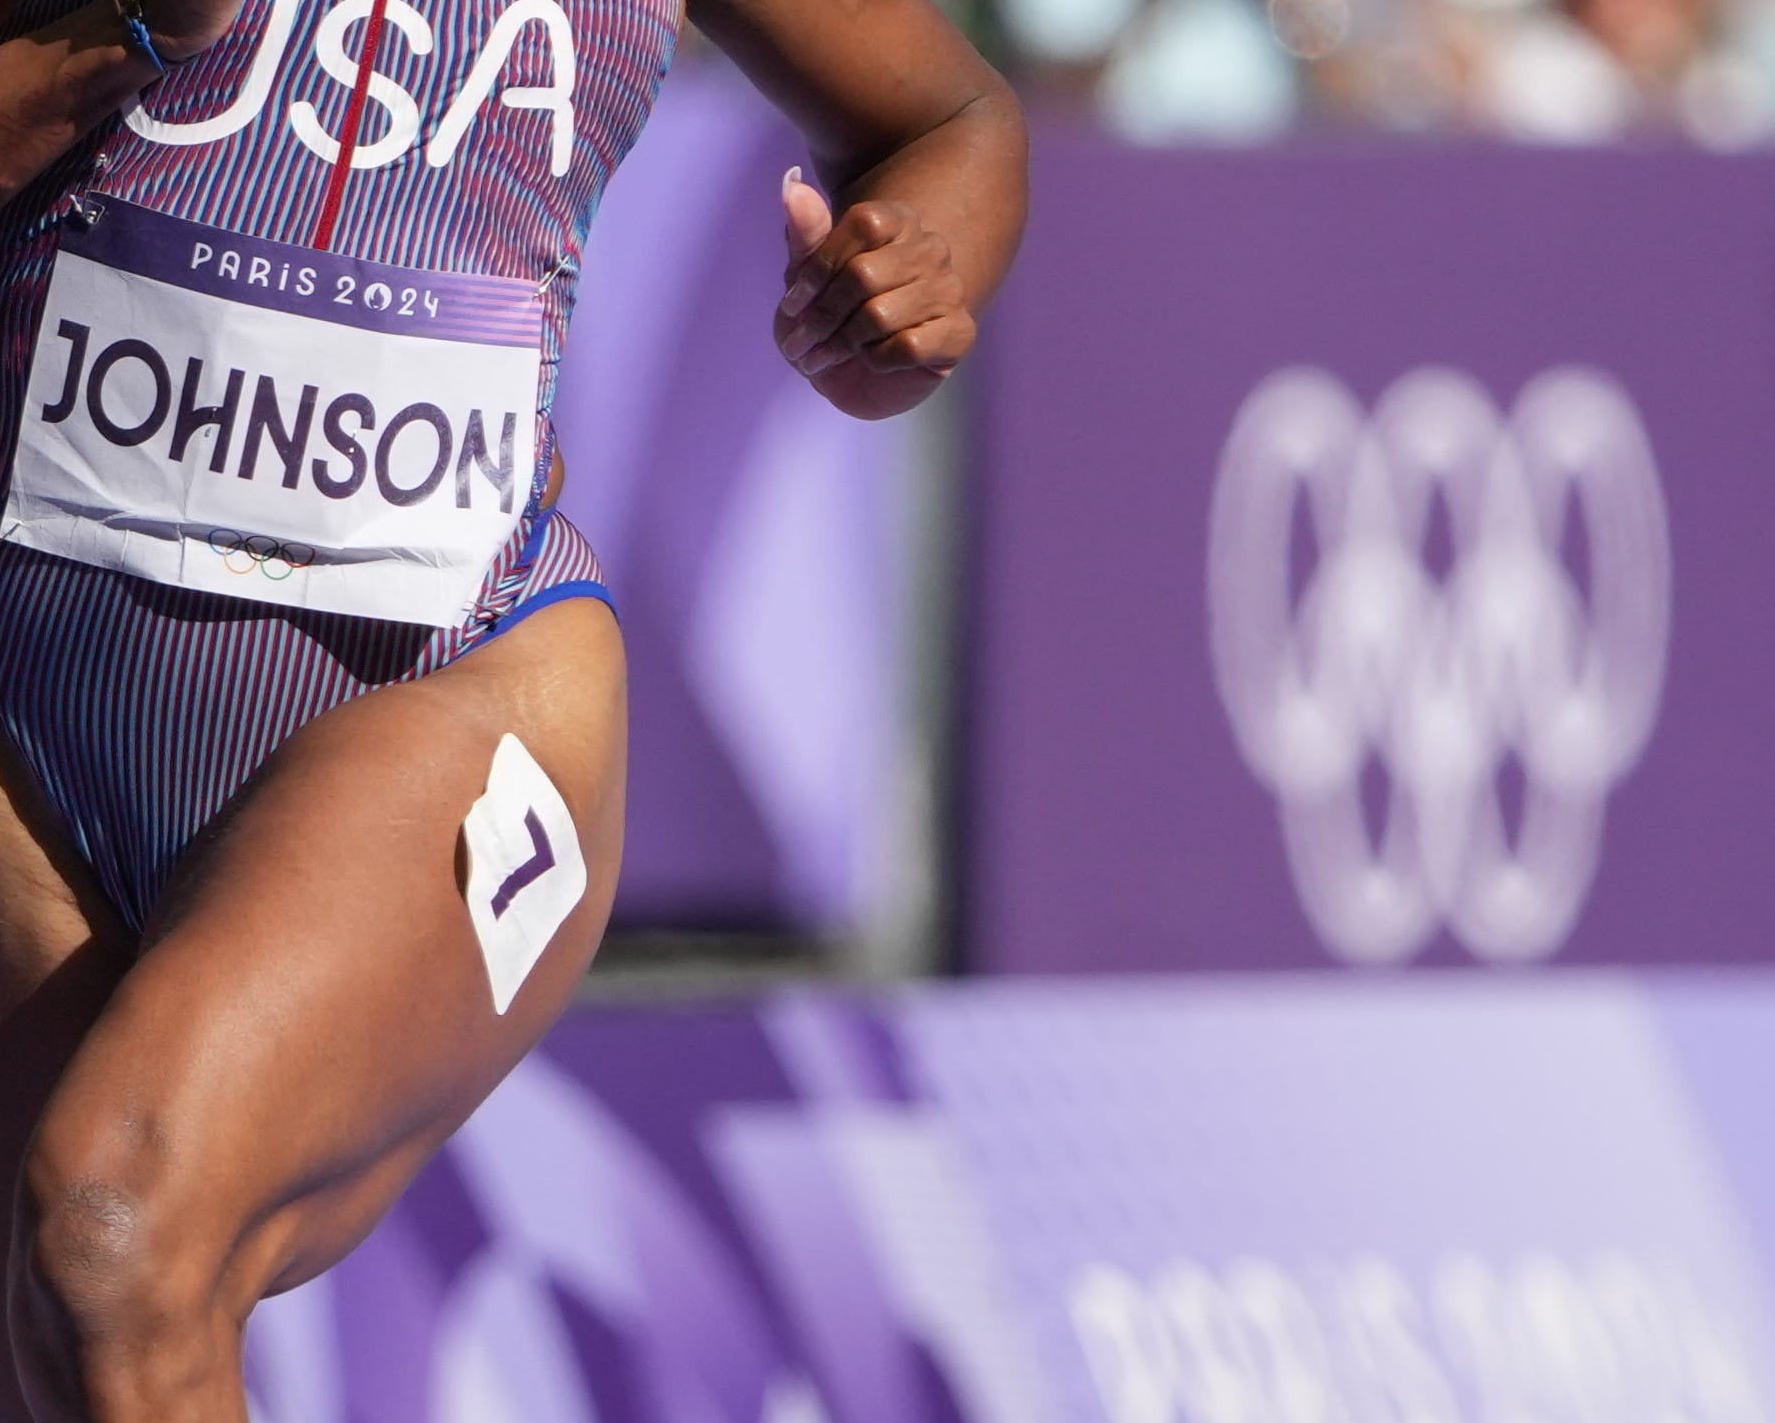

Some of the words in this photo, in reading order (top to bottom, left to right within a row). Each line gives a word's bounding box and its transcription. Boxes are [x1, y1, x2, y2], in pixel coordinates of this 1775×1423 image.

[191, 243, 316, 297] PARIS
[333, 276, 440, 319] 2024
[42, 319, 517, 514] JOHNSON
[490, 804, 556, 921] 7
